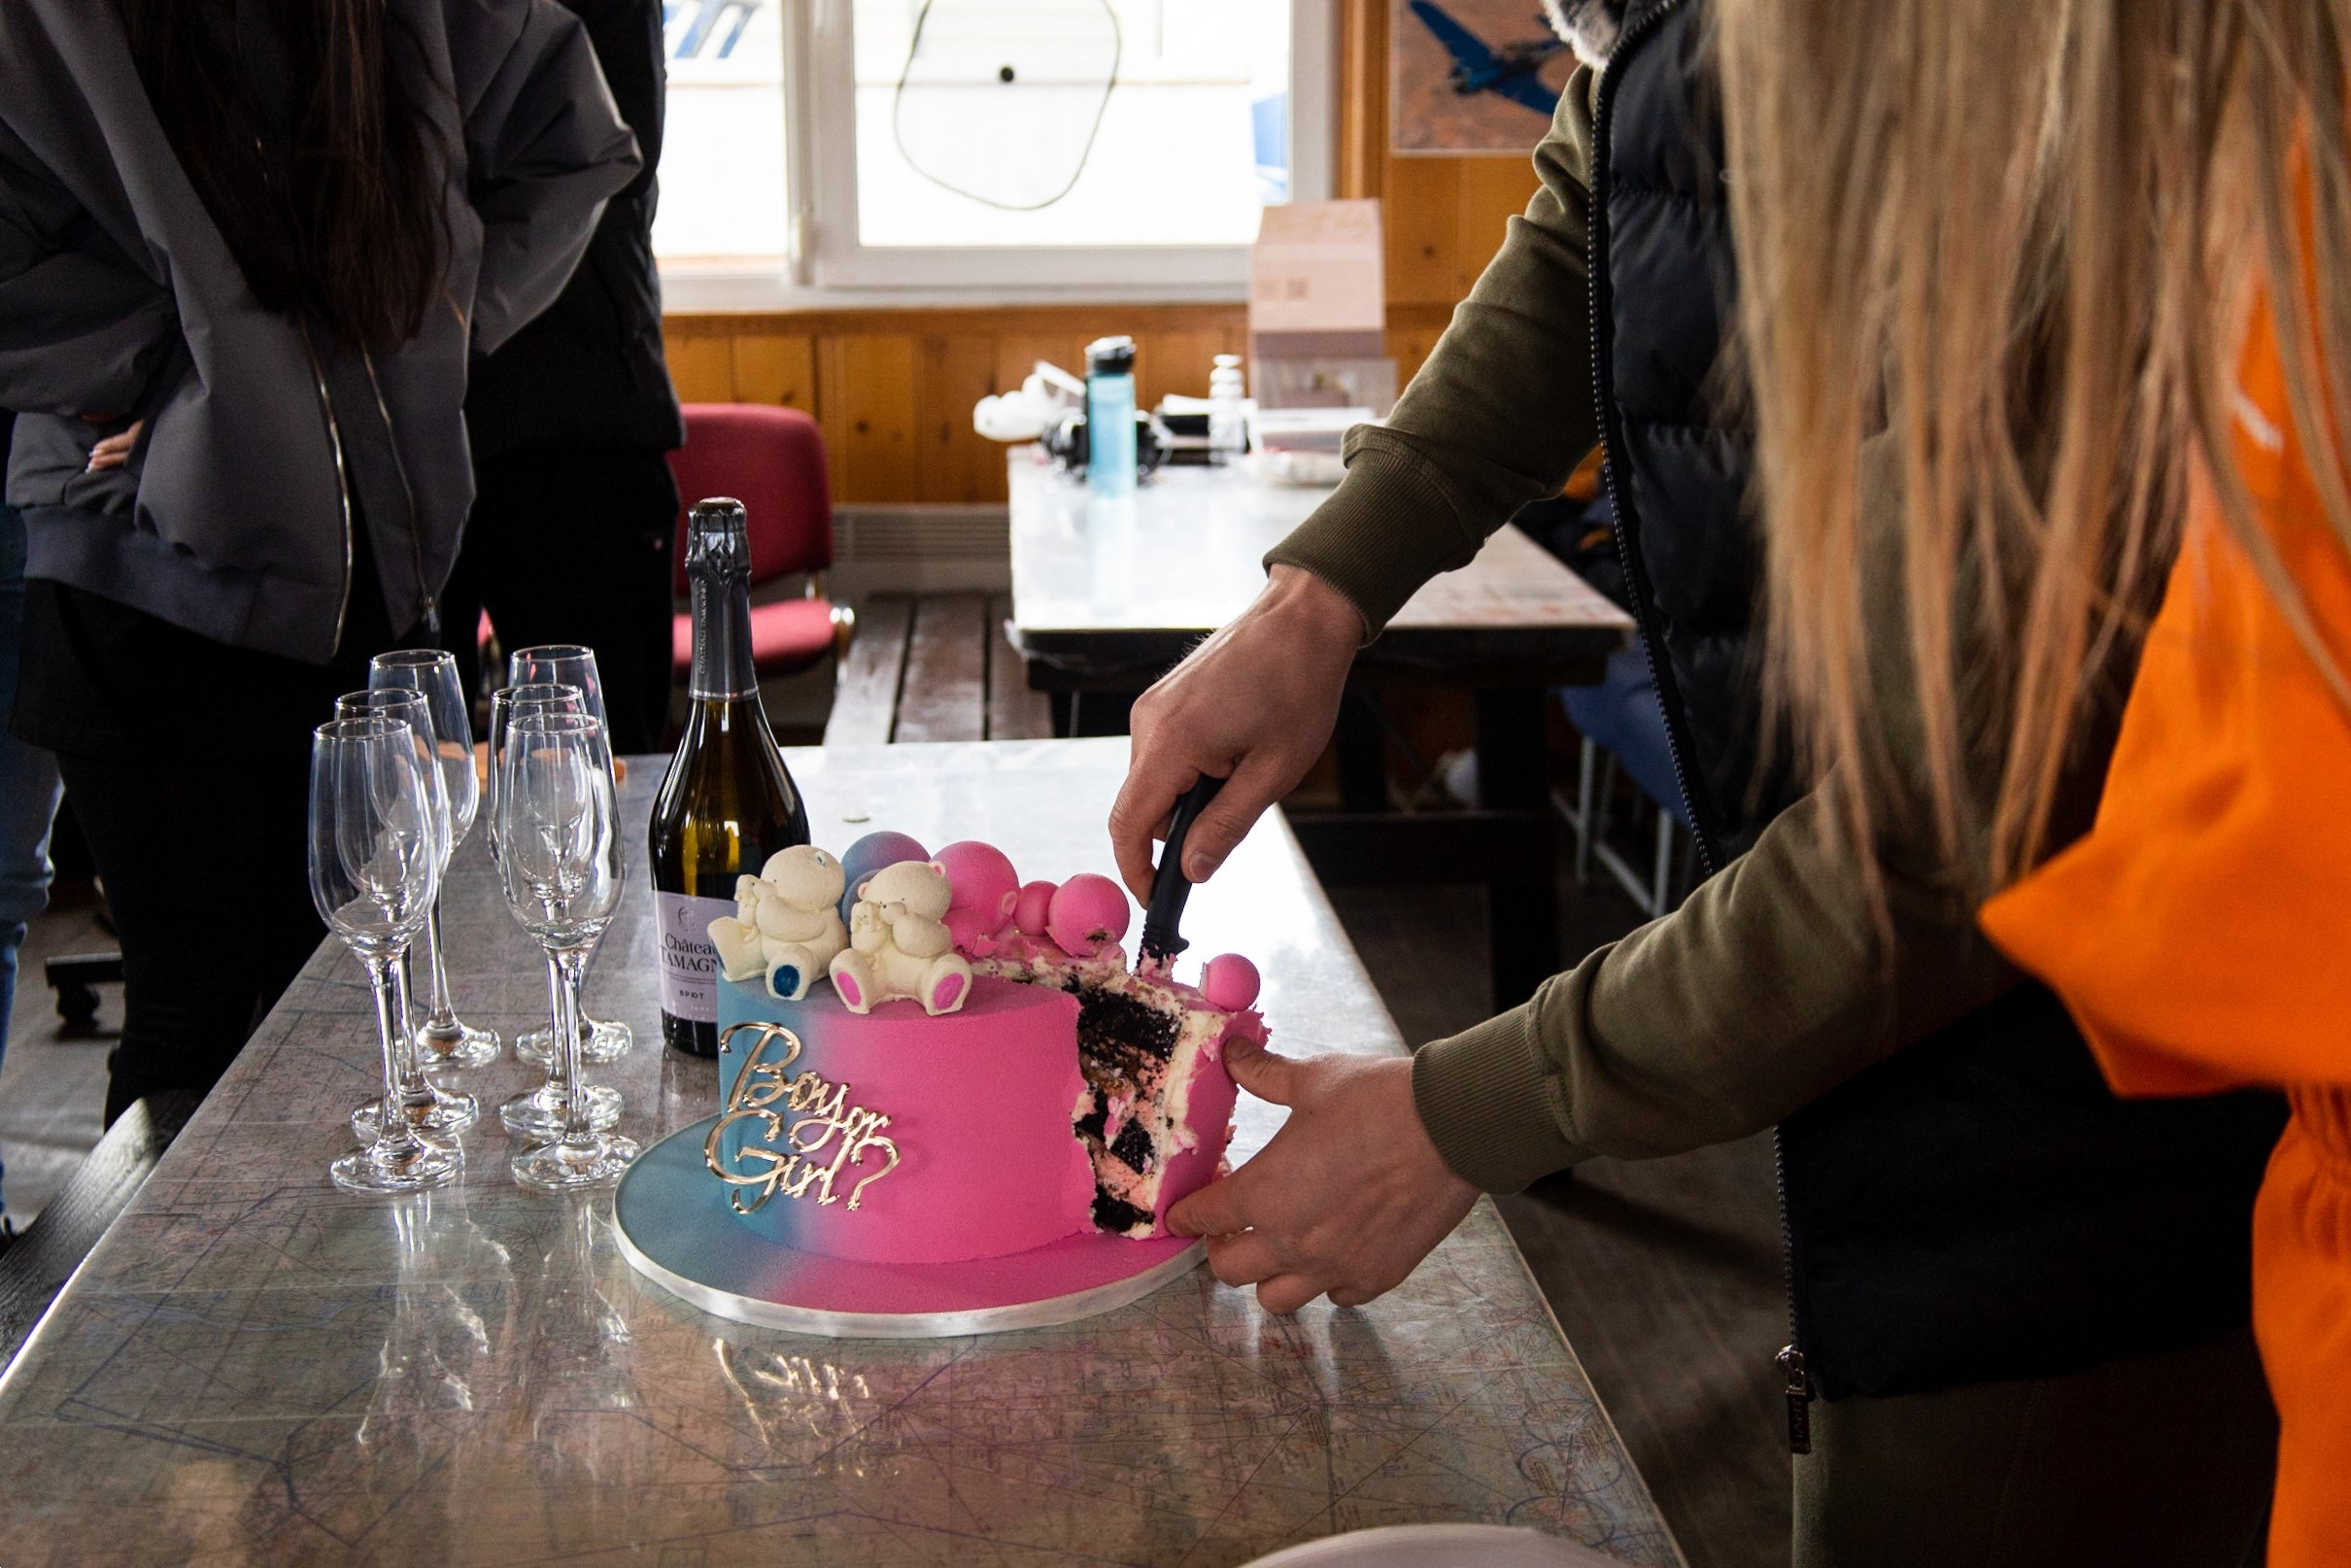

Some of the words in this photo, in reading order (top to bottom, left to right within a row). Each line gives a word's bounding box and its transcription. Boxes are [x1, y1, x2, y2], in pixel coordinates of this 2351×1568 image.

[720, 1021, 850, 1153] Boy
[844, 1105, 892, 1140] or
[704, 1108, 901, 1215] Girl?
